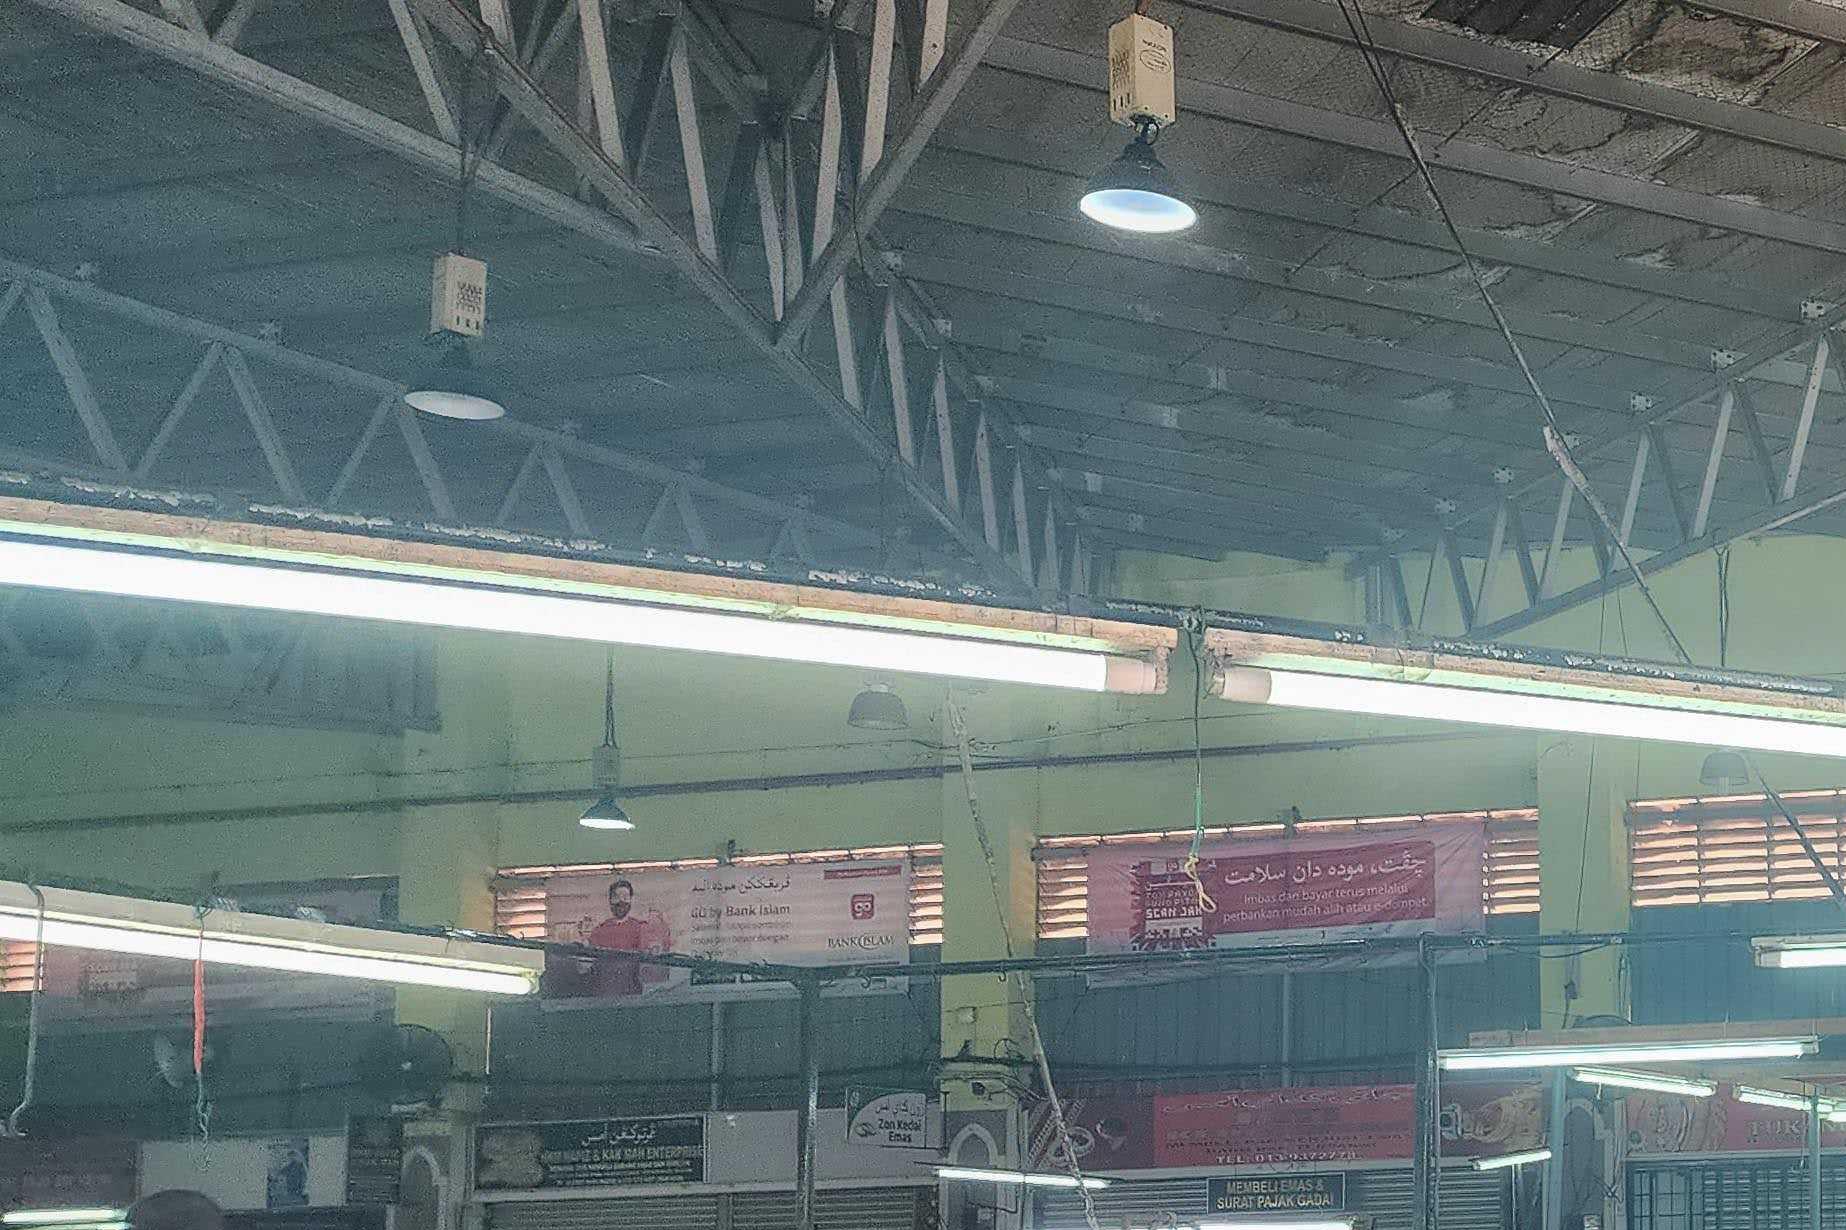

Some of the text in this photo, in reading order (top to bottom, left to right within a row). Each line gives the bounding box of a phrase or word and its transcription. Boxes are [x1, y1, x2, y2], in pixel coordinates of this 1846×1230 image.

[726, 904, 756, 917] Bank
[759, 903, 791, 917] Islam
[888, 1131, 912, 1142] Emas
[1226, 1180, 1278, 1195] MEMBELI
[1280, 1179, 1313, 1192] EMAS
[1216, 1196, 1254, 1210] SURAT
[1256, 1195, 1295, 1209] PAJAK
